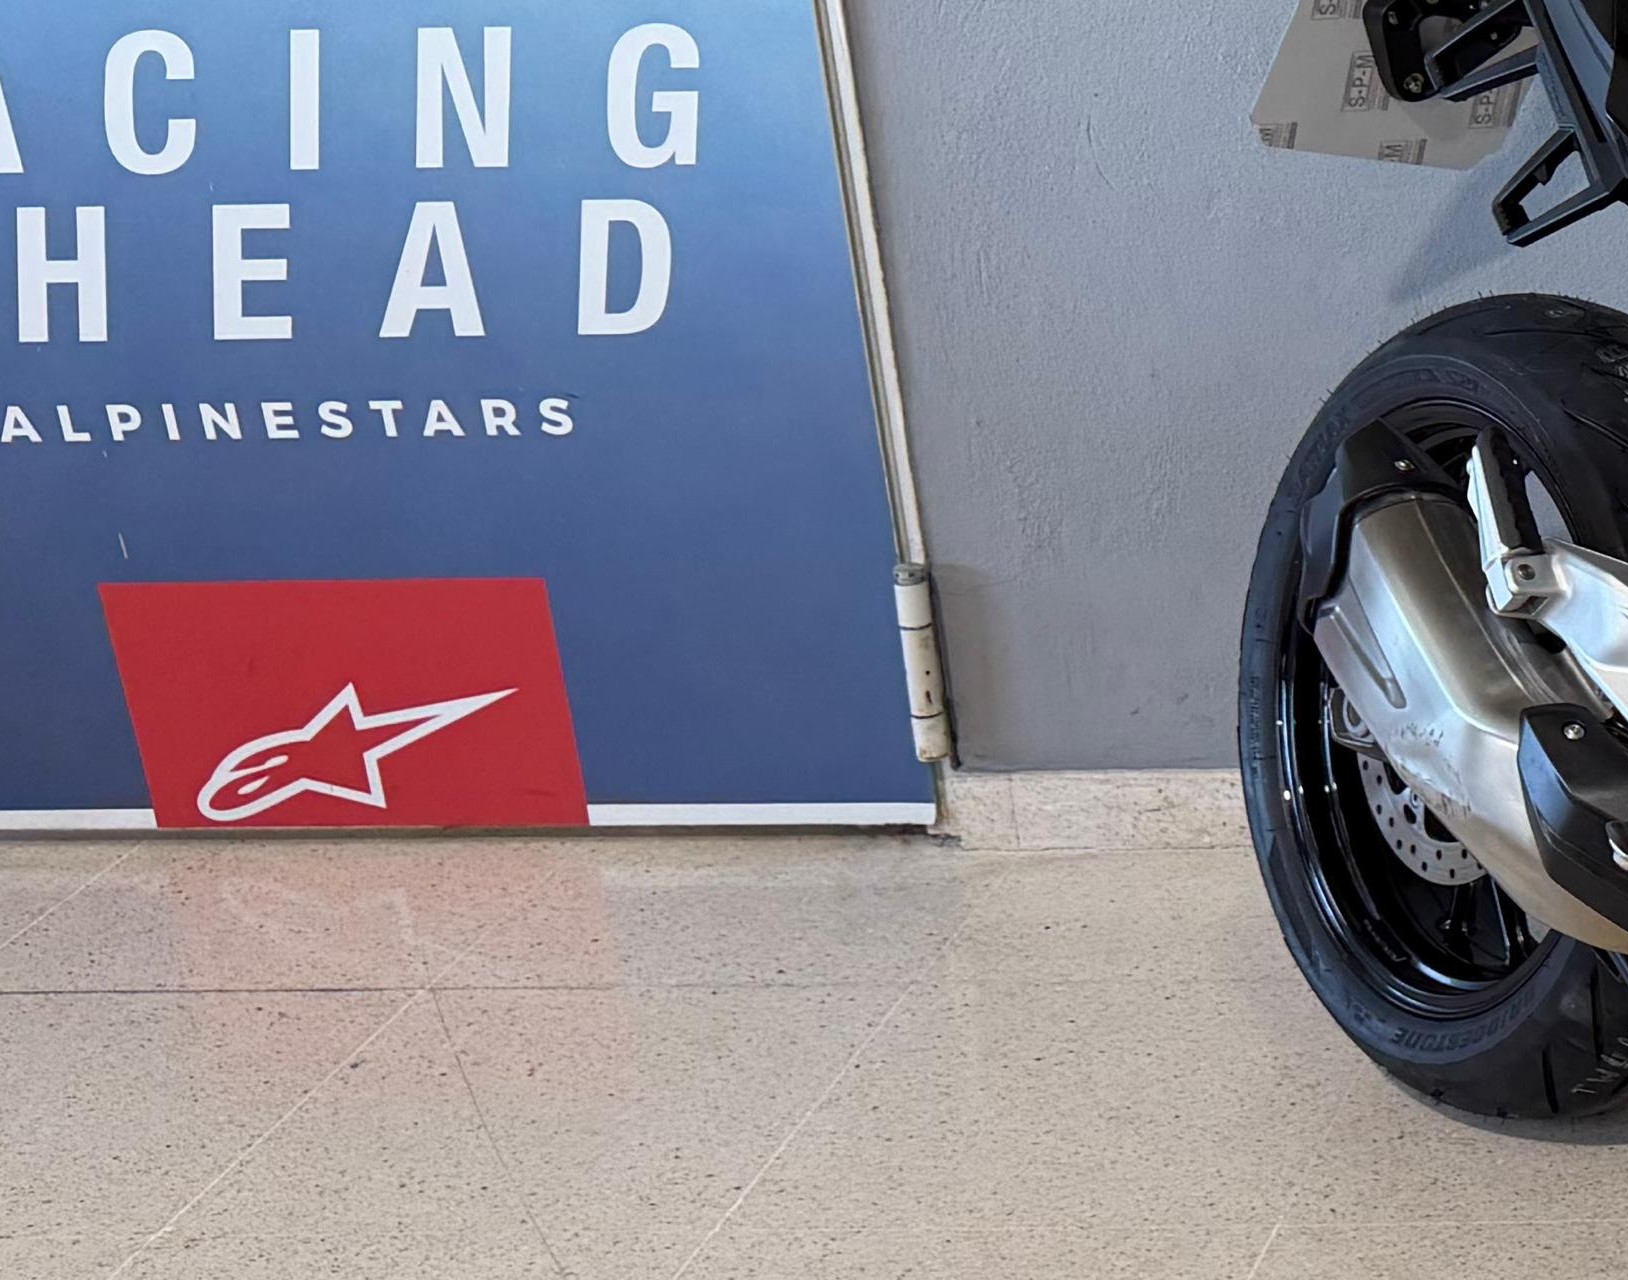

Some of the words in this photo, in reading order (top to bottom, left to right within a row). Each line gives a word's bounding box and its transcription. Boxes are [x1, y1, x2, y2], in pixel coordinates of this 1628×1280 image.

[0, 22, 701, 175] CING
[1475, 87, 1498, 125] S-P-
[1, 397, 575, 443] ALPINESTARS
